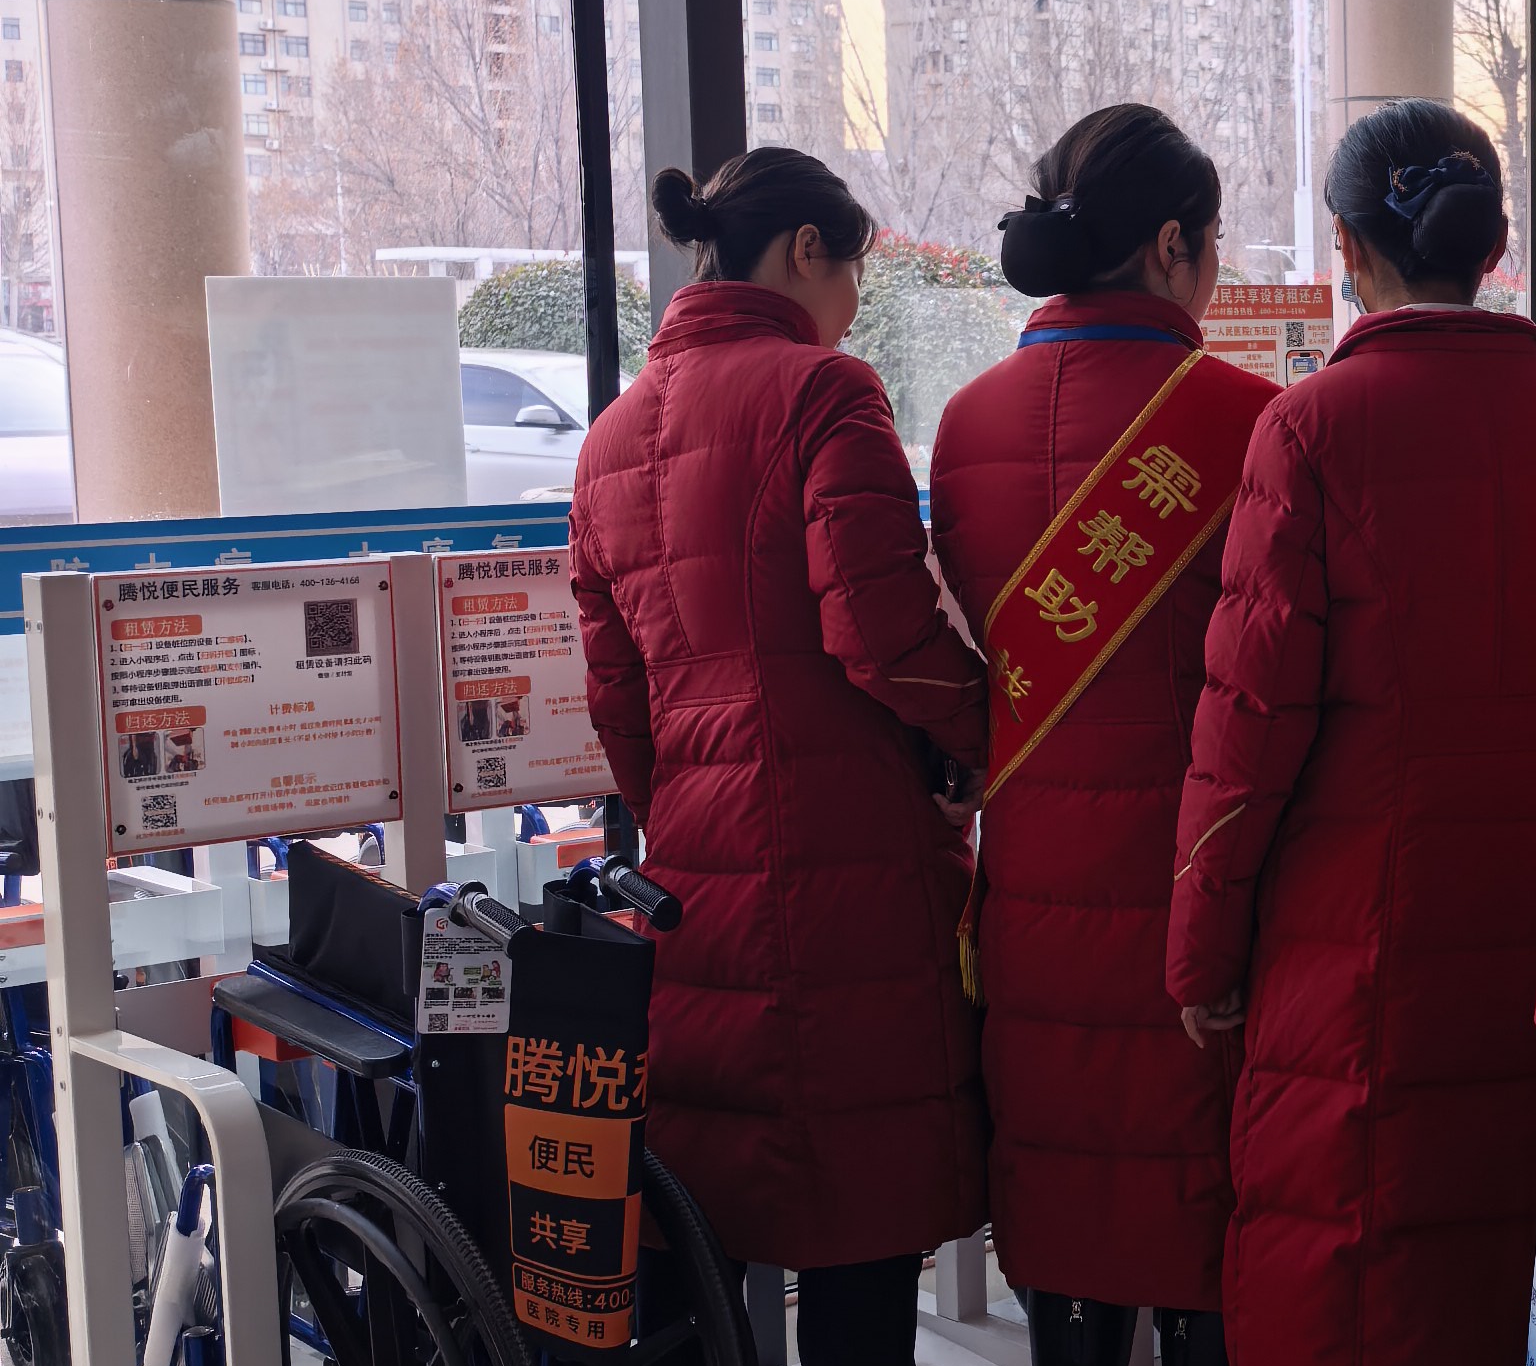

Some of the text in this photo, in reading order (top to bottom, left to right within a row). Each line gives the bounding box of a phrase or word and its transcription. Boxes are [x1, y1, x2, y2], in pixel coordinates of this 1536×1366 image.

[458, 558, 560, 581] 腾悦便民服务
[118, 577, 240, 603] 腾悦便民服务
[463, 595, 518, 612] 租赁方法
[123, 618, 190, 637] 租赁方法
[295, 654, 372, 670] 租赁设备请扫此码
[463, 681, 518, 698] 归还方法
[269, 701, 316, 716] 计费标准
[125, 711, 191, 730] 归还方法
[529, 1135, 594, 1179] 便民
[530, 1211, 591, 1255] 共享
[527, 1299, 605, 1340] 医院专用
